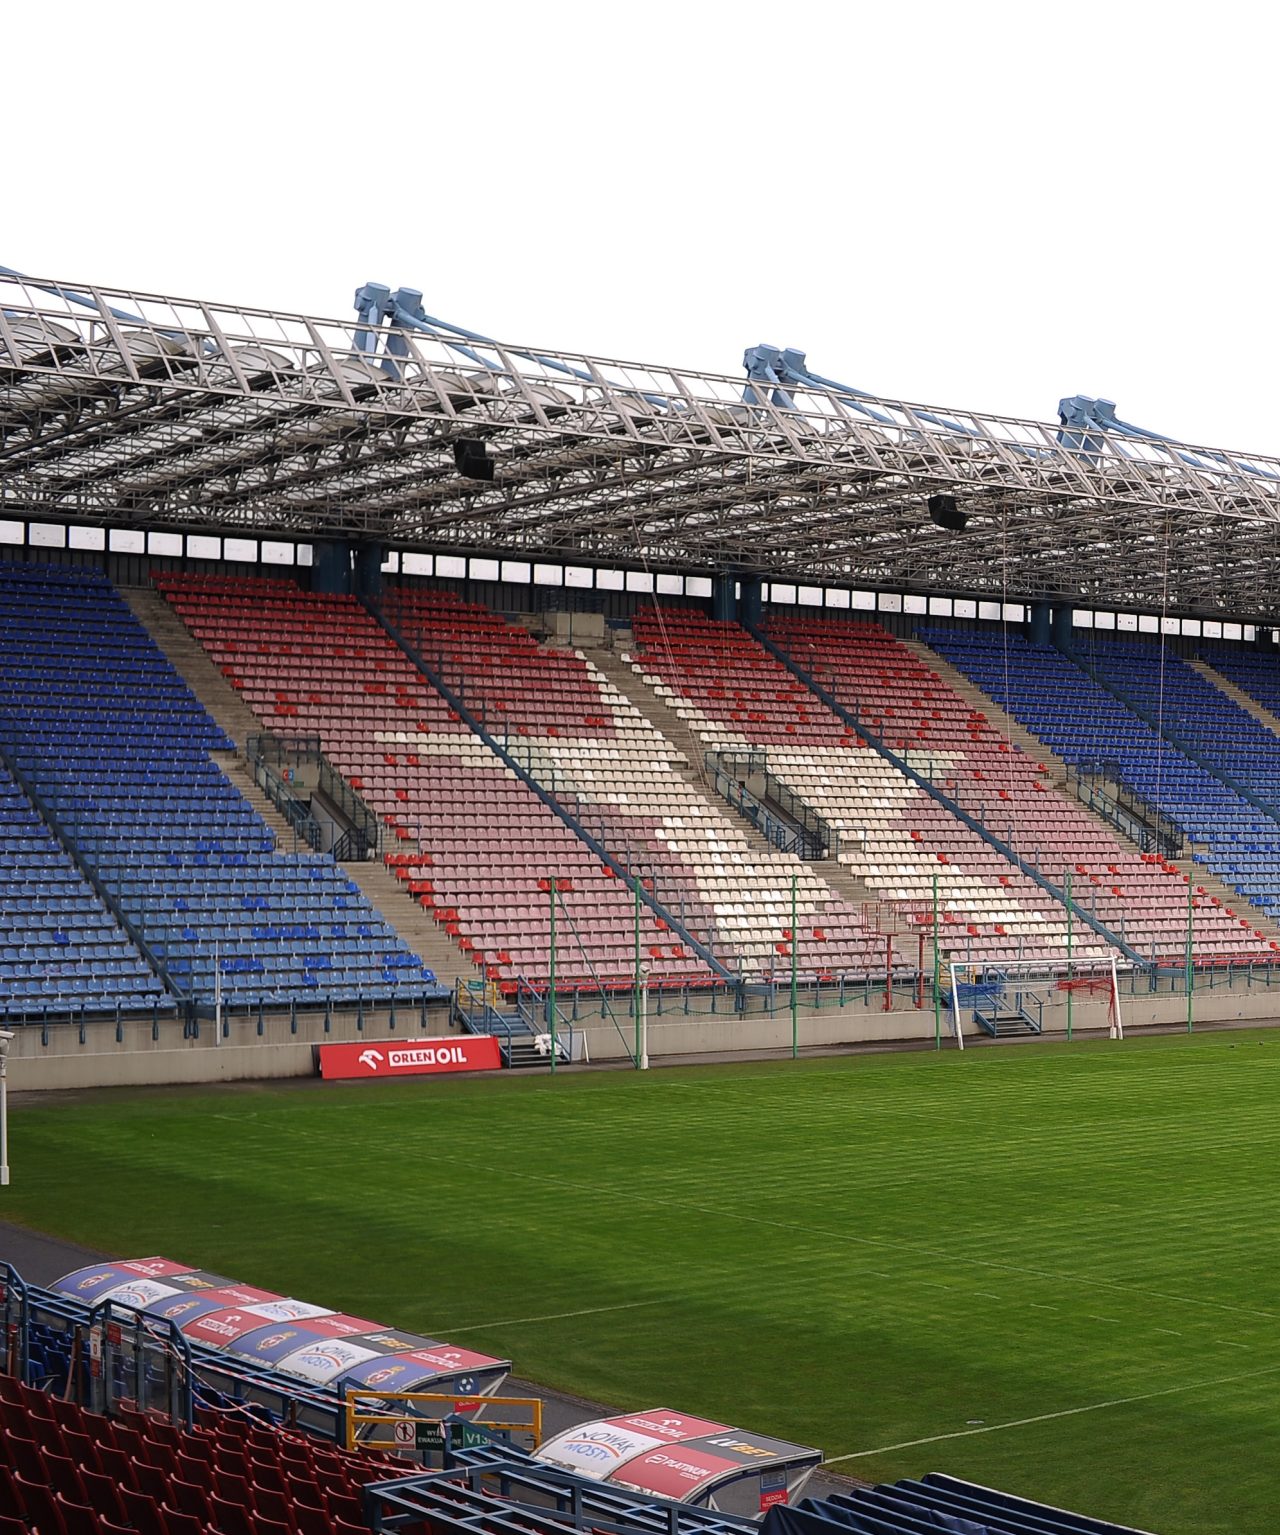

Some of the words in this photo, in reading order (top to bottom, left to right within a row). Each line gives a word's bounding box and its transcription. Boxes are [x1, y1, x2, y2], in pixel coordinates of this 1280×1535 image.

[391, 1052, 432, 1063] ORLEN
[436, 1047, 467, 1064] OIL
[576, 1431, 635, 1454] NOWAK
[706, 1438, 778, 1457] LVBET
[564, 1443, 610, 1461] MOSTY
[663, 1459, 712, 1477] PLATINUM
